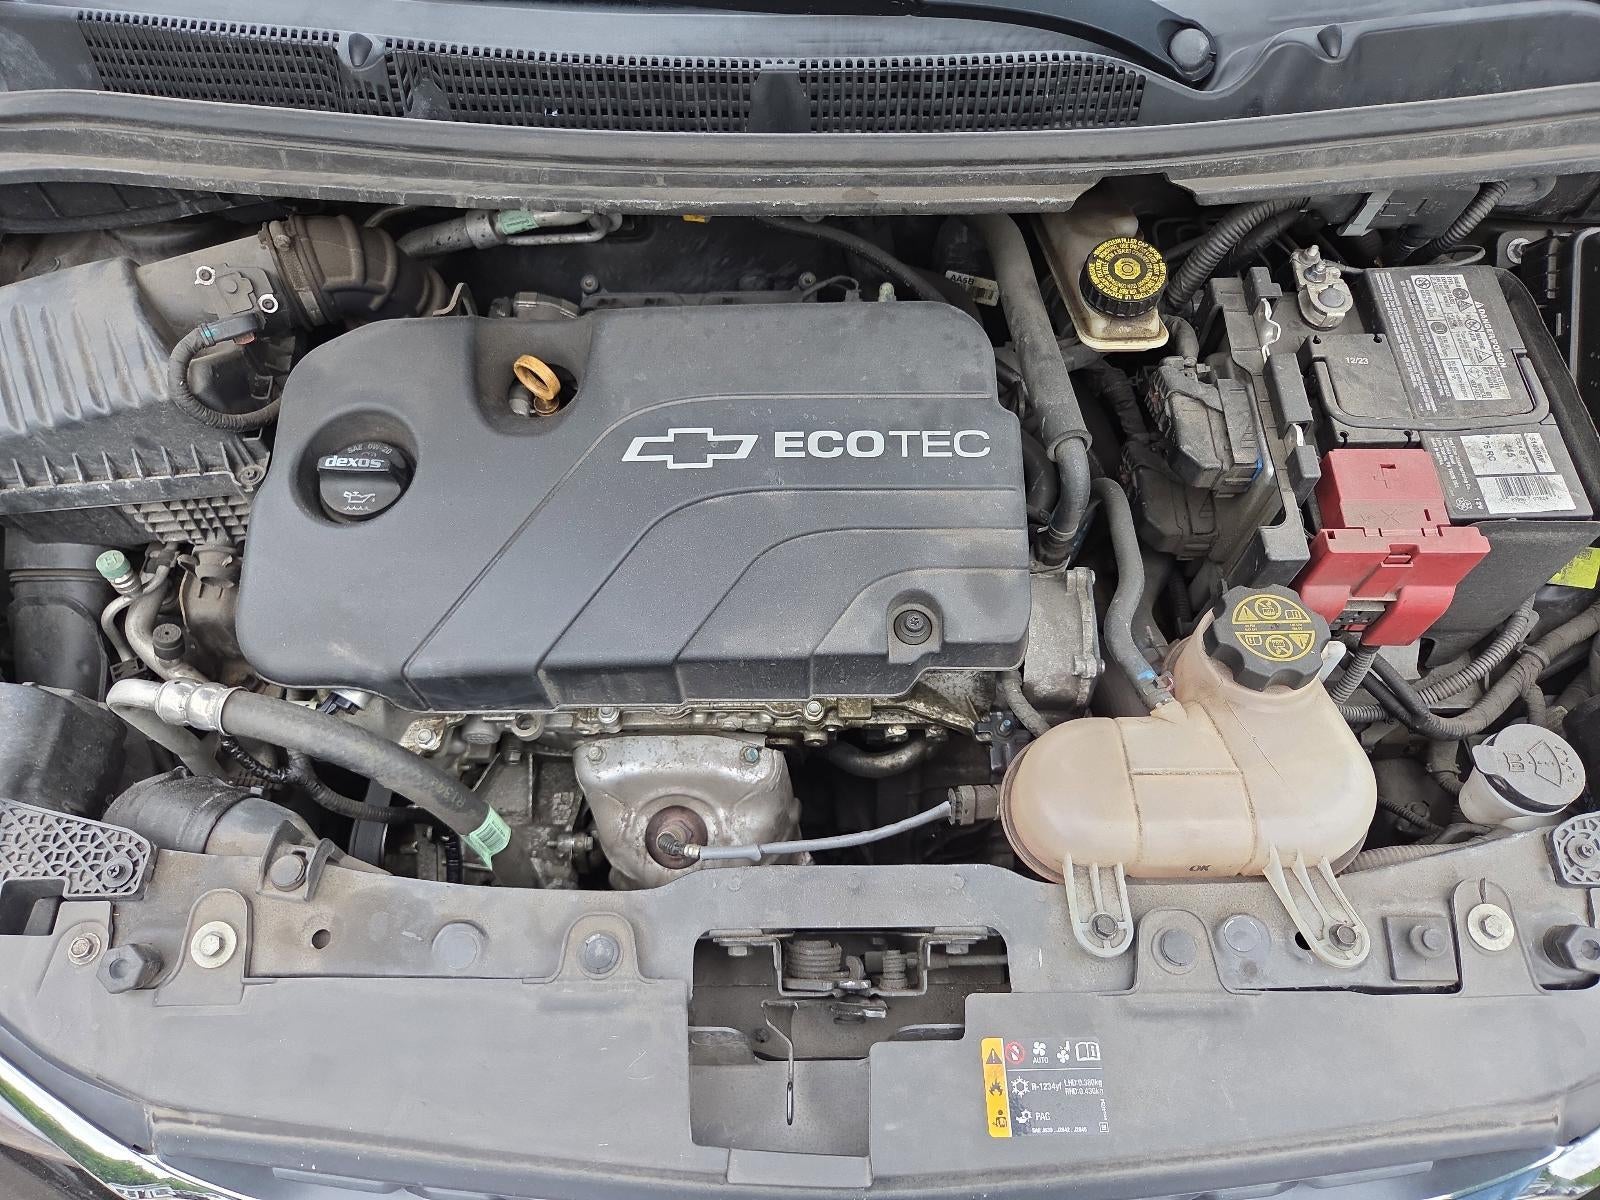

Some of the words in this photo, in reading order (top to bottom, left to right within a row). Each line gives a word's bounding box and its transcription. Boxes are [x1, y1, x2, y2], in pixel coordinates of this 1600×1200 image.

[1345, 356, 1369, 365] 12/23
[347, 443, 363, 454] SAE
[324, 455, 385, 468] dexos
[1486, 450, 1497, 462] RC
[1032, 1056, 1048, 1064] AUTO
